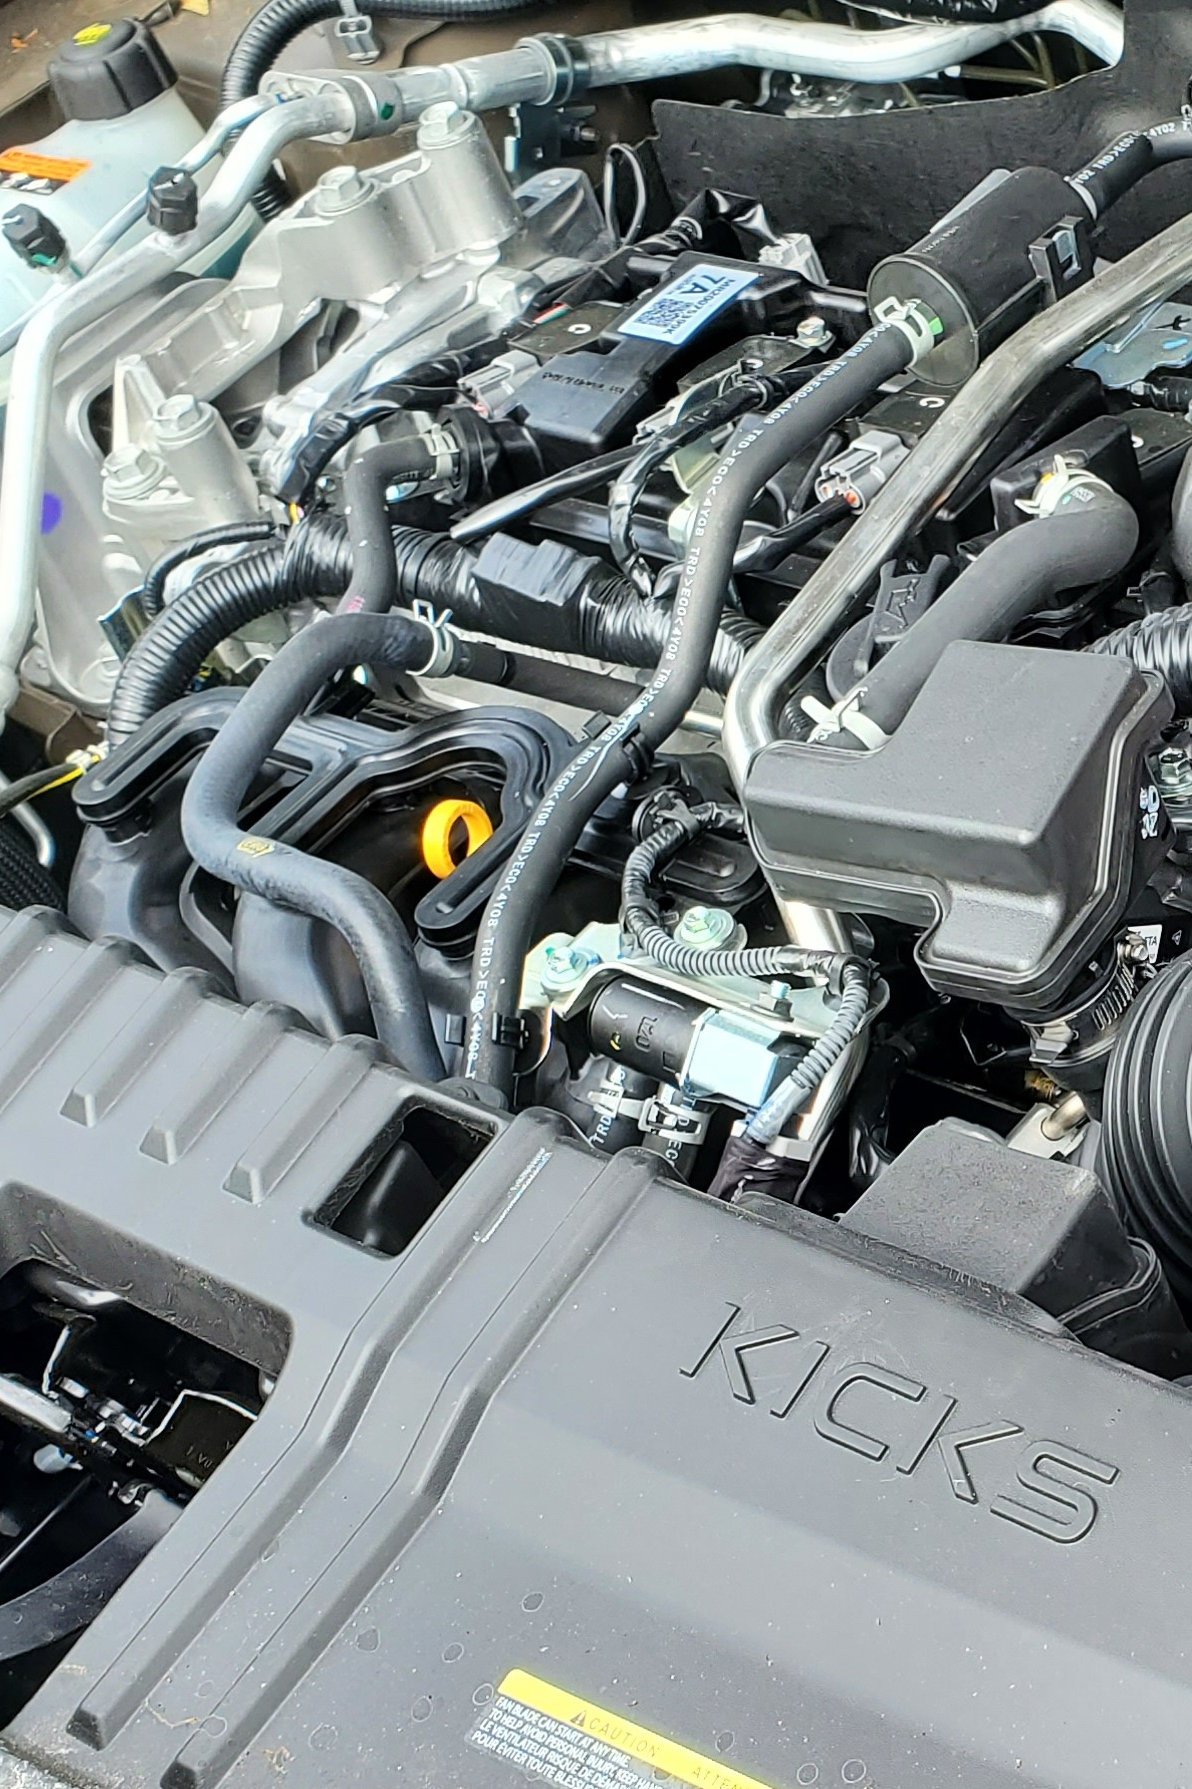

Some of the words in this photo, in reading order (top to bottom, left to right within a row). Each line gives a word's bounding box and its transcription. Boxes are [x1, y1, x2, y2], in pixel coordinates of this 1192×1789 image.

[679, 274, 727, 295] 7A
[680, 1301, 1120, 1544] KICKS
[471, 1730, 501, 1751] POUR
[525, 1755, 558, 1779] TOUTE
[480, 1717, 495, 1733] LE
[491, 1724, 550, 1760] VENTILATEUR
[545, 1750, 581, 1776] RISQUE
[577, 1765, 595, 1780] DE
[489, 1707, 503, 1722] TO
[500, 1713, 524, 1731] HELP
[519, 1723, 549, 1744] AVOID
[544, 1734, 590, 1764] PERSONAL
[615, 1767, 639, 1786] KEEP
[495, 1695, 516, 1714] FAN
[511, 1703, 542, 1726] BLADE
[537, 1715, 560, 1734] CAN
[554, 1724, 584, 1746] START
[578, 1736, 595, 1749] AT
[589, 1740, 611, 1760] ANY
[589, 1716, 661, 1759] CAUTION
